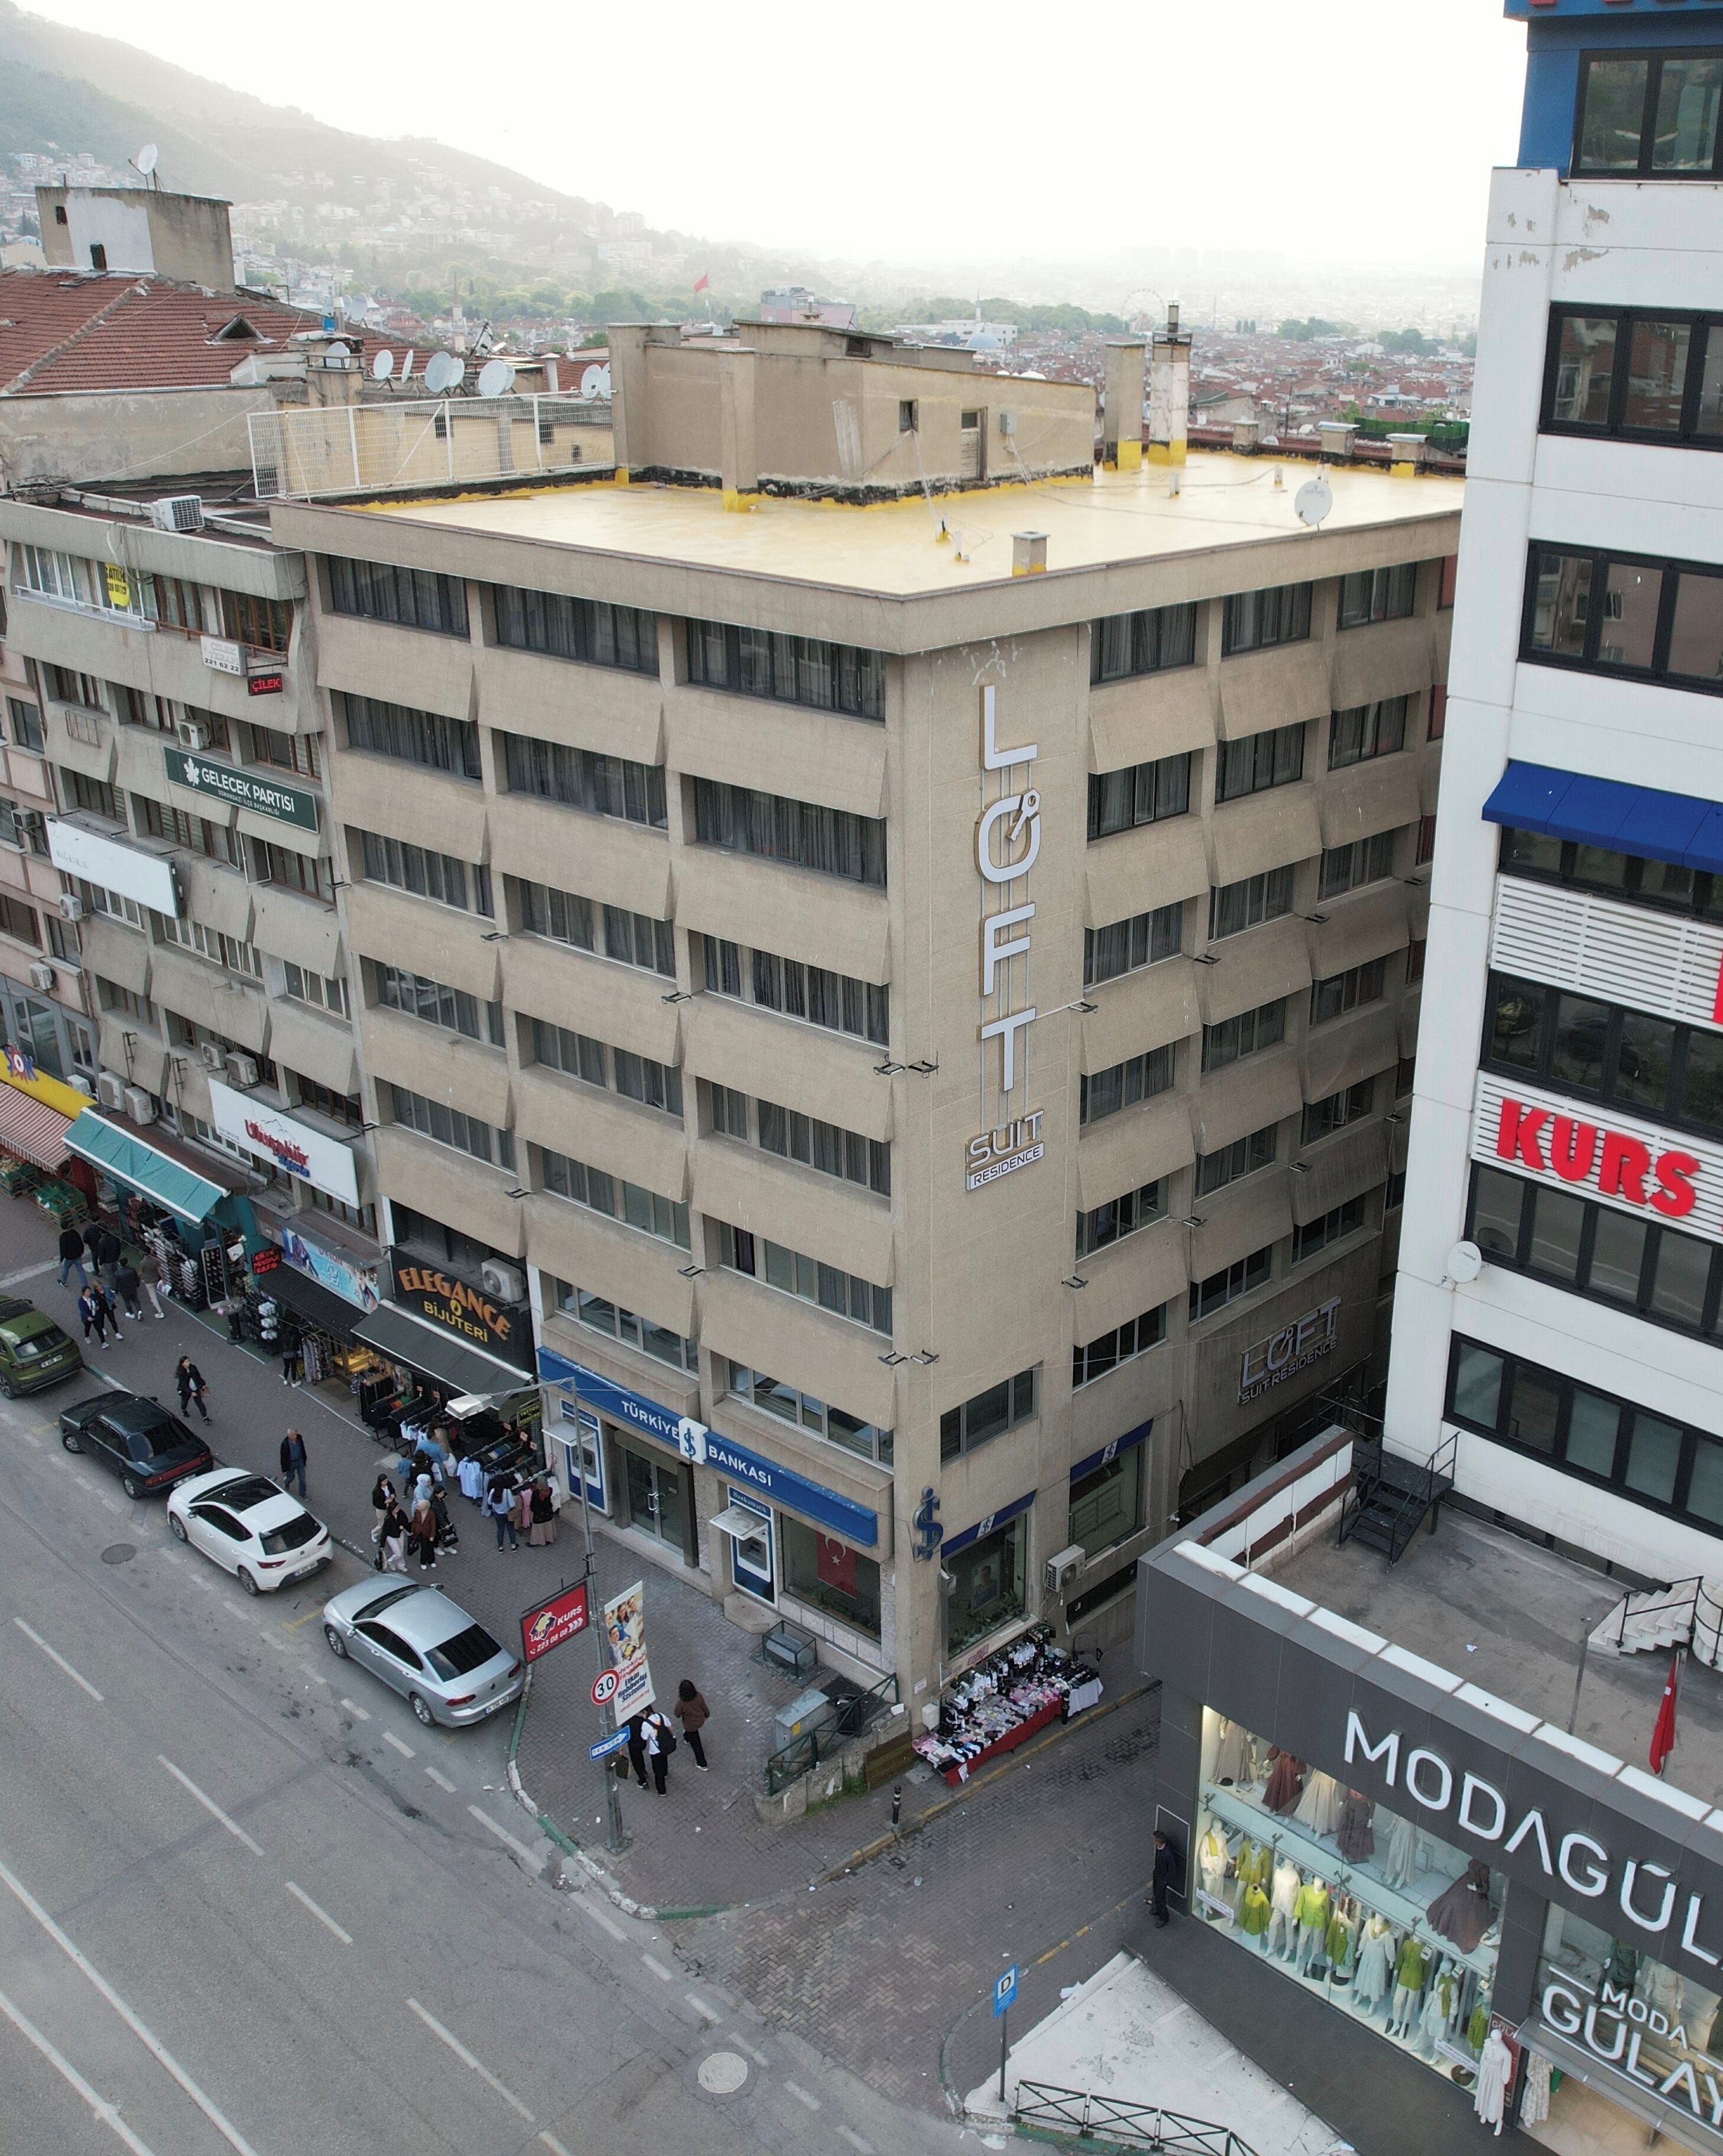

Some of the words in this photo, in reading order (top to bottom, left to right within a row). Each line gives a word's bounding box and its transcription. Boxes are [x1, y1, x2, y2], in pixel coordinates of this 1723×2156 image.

[252, 678, 280, 692] ÇİLEK
[201, 767, 251, 798] GELECEK
[252, 785, 296, 813] PARTİSİ
[218, 789, 242, 803] OSMANGAZİ
[243, 798, 254, 807] İLÇE
[254, 803, 280, 816] BAŞKANLIĞI
[975, 683, 1041, 1092] LOFT
[969, 1109, 1044, 1168] SUIT
[1497, 1098, 1702, 1217] KURS
[974, 1146, 1040, 1186] RESIDENCE
[398, 1267, 512, 1341] ELEGANCE
[423, 1300, 489, 1343] BİJUTERİ
[1242, 1295, 1342, 1388] LOFT
[1242, 1378, 1270, 1405] SUIT
[1271, 1336, 1338, 1387] RESIDENCE
[520, 1404, 540, 1417] TATTOO
[621, 1400, 680, 1440] TÜRKİYE
[708, 1444, 772, 1487] BANKASI
[732, 1491, 767, 1514] Bankamatik
[557, 1605, 582, 1626] KURS
[597, 1676, 614, 1697] 30
[622, 1680, 646, 1703] Sistemi
[625, 1671, 640, 1687] Etkin
[593, 1746, 605, 1755] TEK
[1001, 1976, 1011, 1995] D
[1601, 1982, 1688, 2050] MODA
